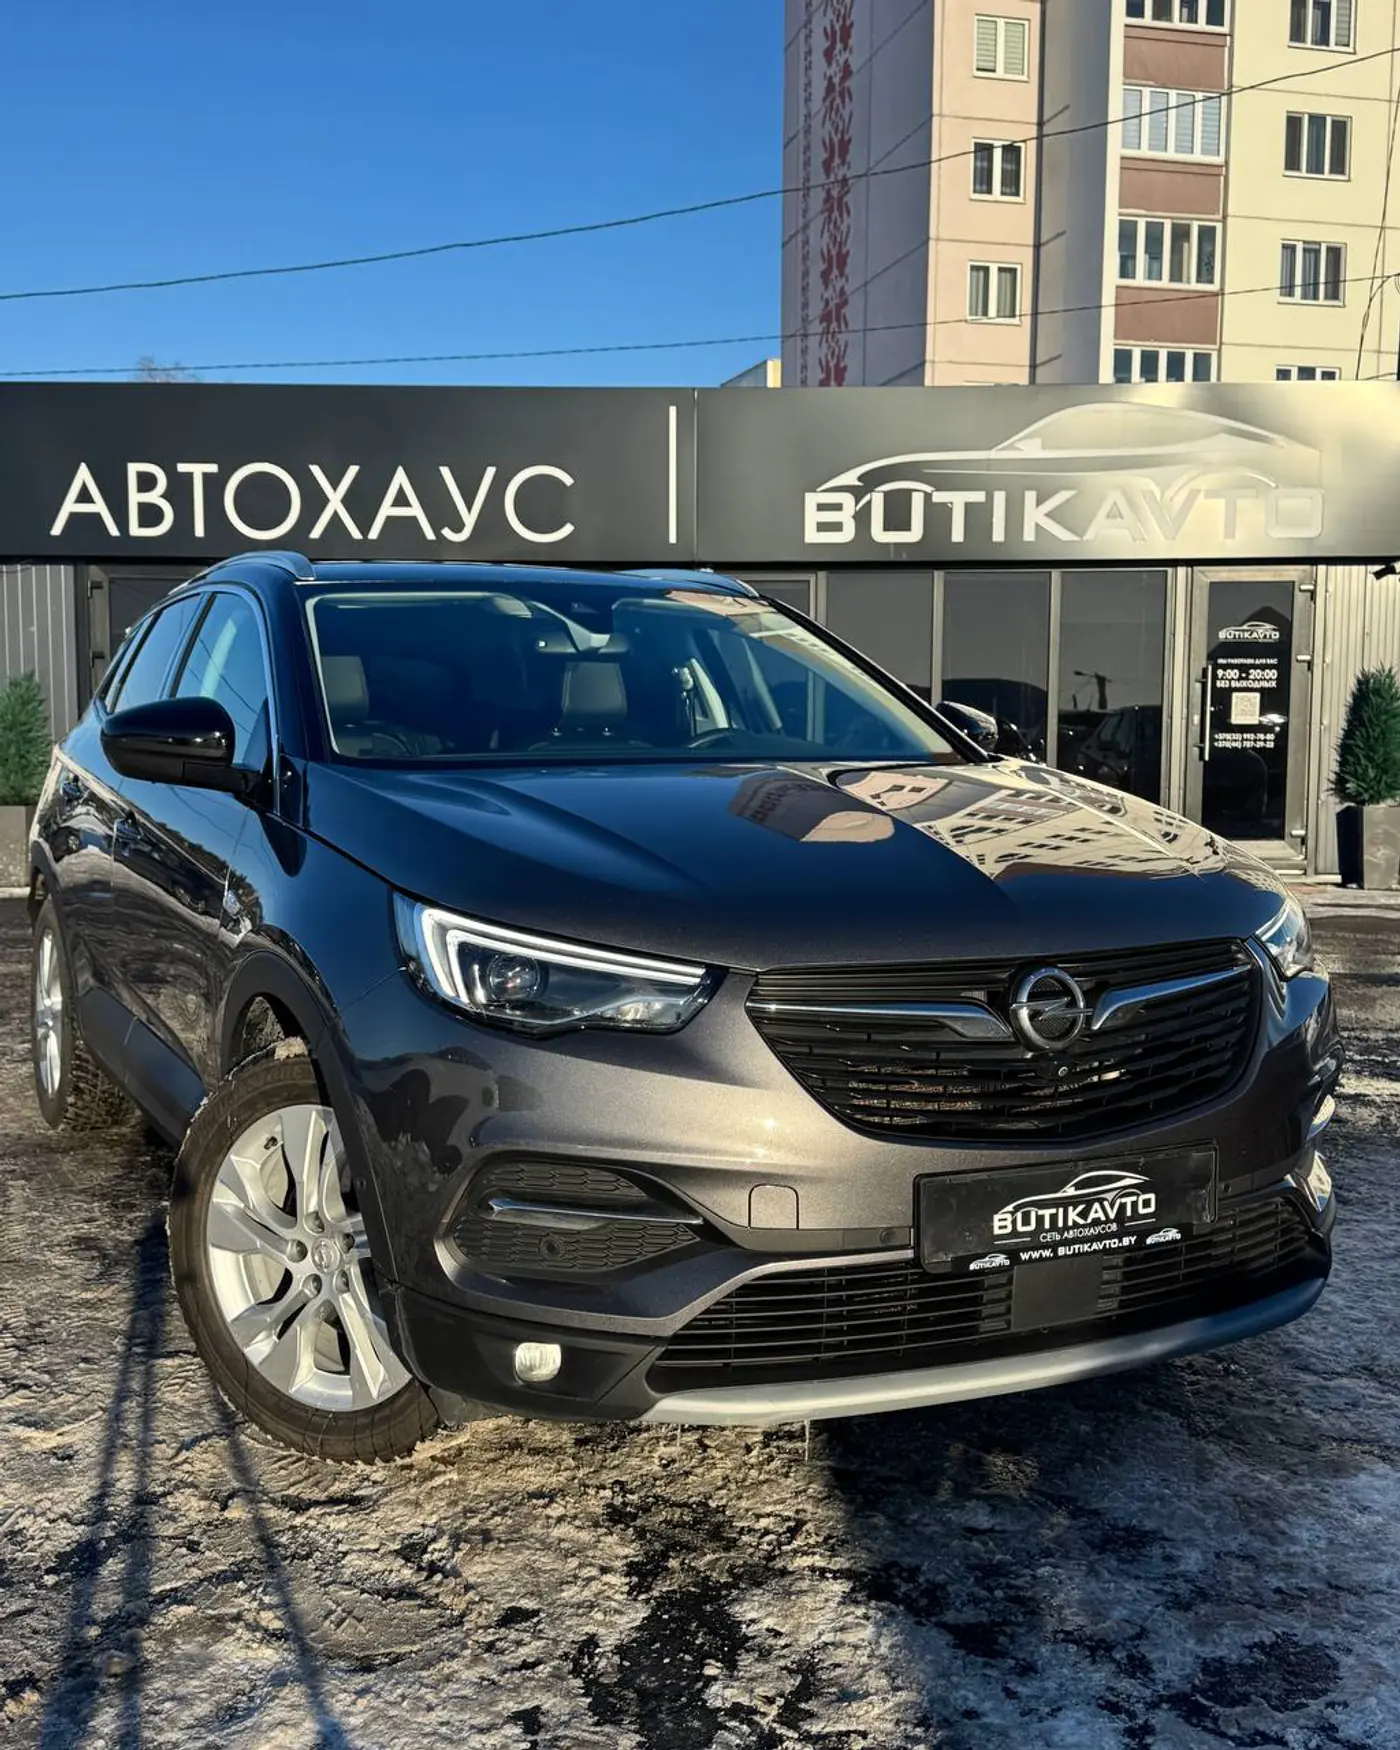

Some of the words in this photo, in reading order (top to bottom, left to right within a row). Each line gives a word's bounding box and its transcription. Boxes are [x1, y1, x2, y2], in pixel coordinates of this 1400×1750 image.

[50, 461, 575, 543] АВТОХАУС
[804, 487, 1325, 543] BUTIKAVTO
[1218, 630, 1280, 639] BUTIKAVTO
[1216, 669, 1239, 679] 9:00
[1248, 669, 1278, 679] 20:00
[1216, 680, 1229, 688] БЕЗ
[1230, 680, 1277, 688] ВЫХОДНЫХ
[993, 1193, 1156, 1235] BUTIKAVTO
[1039, 1231, 1062, 1243] СЕТЬ
[1063, 1222, 1118, 1240] АВТОХАУСОВ
[1145, 1232, 1181, 1245] BUTIKAVTO
[1020, 1249, 1054, 1261] WWW.
[1057, 1235, 1137, 1256] BUTIKAVTO.BY
[969, 1257, 1010, 1271] BUTIKAVTO
